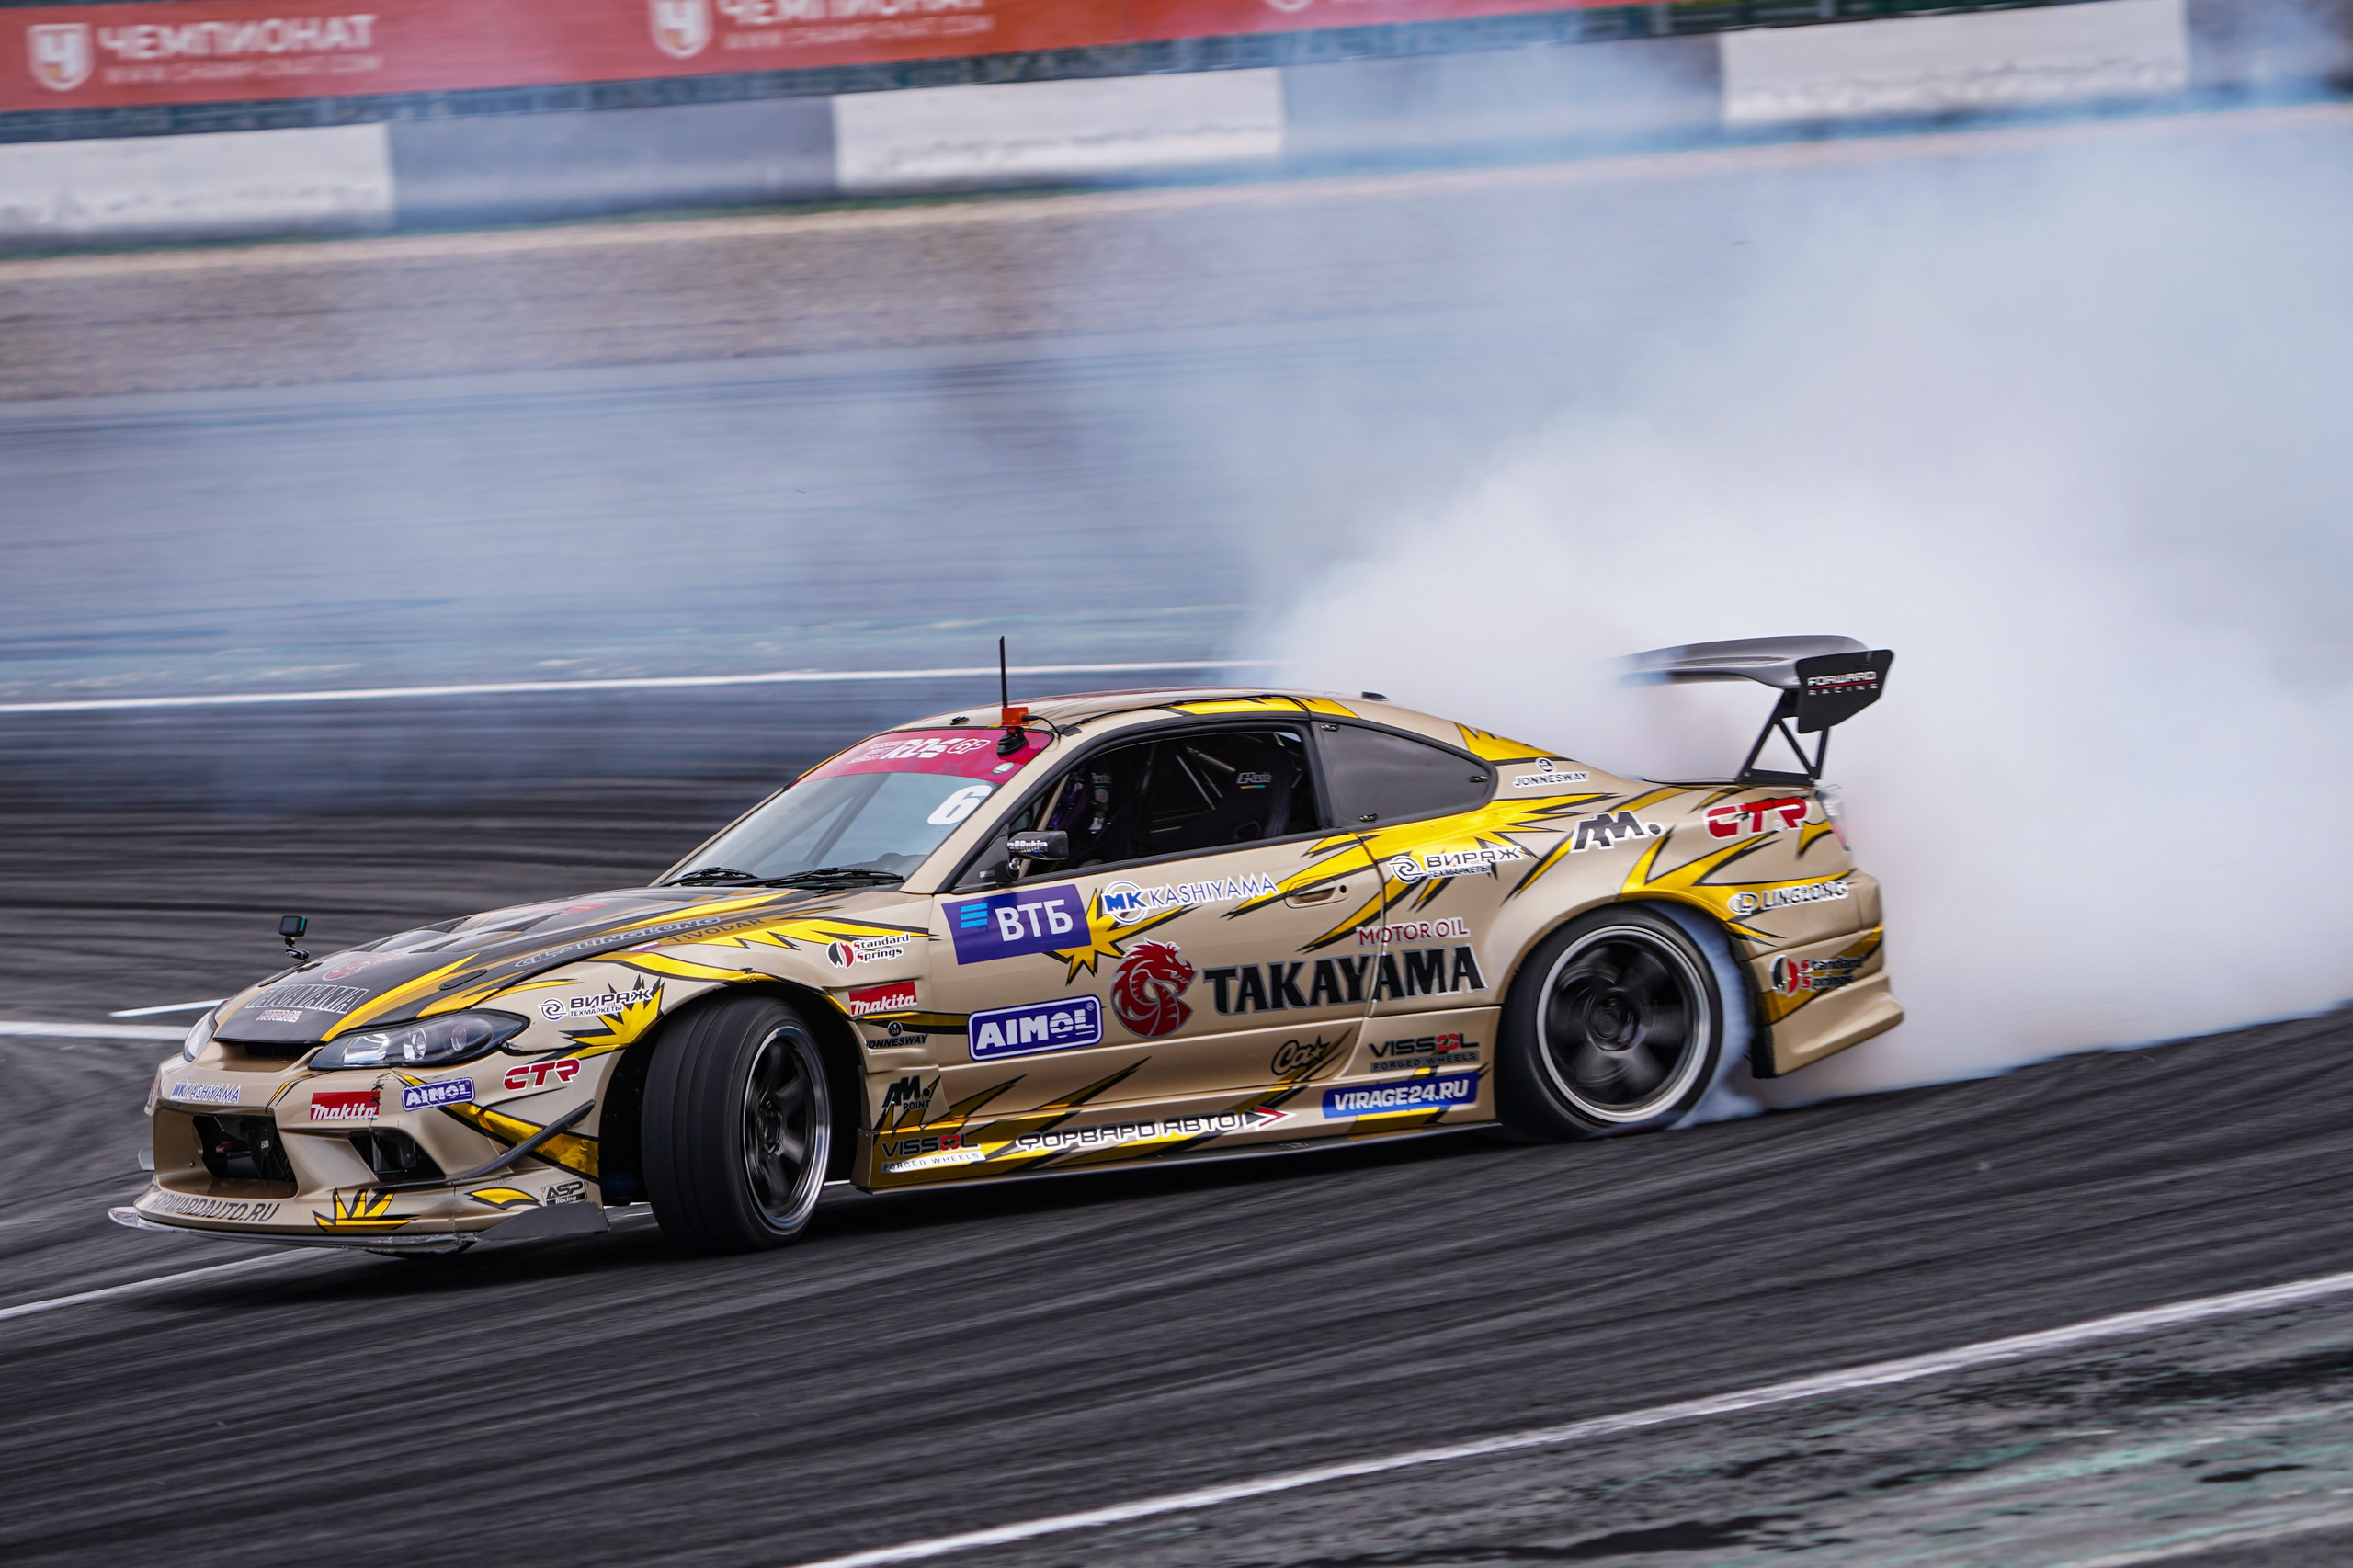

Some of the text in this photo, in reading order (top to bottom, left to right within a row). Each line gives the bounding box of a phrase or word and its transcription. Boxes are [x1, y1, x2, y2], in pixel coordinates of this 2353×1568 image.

[97, 14, 378, 60] ЧЕМПИОНАТ
[1515, 772, 1588, 787] JONNESWAY
[926, 784, 993, 825] 6
[1707, 797, 1810, 838] CTR
[1426, 847, 1521, 868] ВИРАЖ
[1104, 875, 1277, 912] MK KASHIYAMA
[666, 919, 766, 943] TIVODAR
[995, 899, 1074, 942] ВТБ
[853, 934, 910, 949] Standard
[1358, 919, 1469, 946] MOTOR OIL
[857, 948, 903, 962] Springs
[1203, 944, 1487, 1016] TAKAYAMA
[570, 989, 652, 1008] ВИРАЖ
[570, 1006, 623, 1017] ТЕХМАРКЕТЫ
[1374, 1052, 1476, 1071] FORGED WHEELS
[503, 1059, 580, 1091] CTR
[186, 1083, 241, 1103] KASHIYAMA
[406, 1084, 471, 1106] AIMOL
[1335, 1079, 1469, 1111] VIRAGE24.RU
[904, 1099, 931, 1111] POINT
[883, 1153, 980, 1171] FORGED WHEELS
[546, 1181, 583, 1199] ASP
[555, 1196, 576, 1204] Racing
